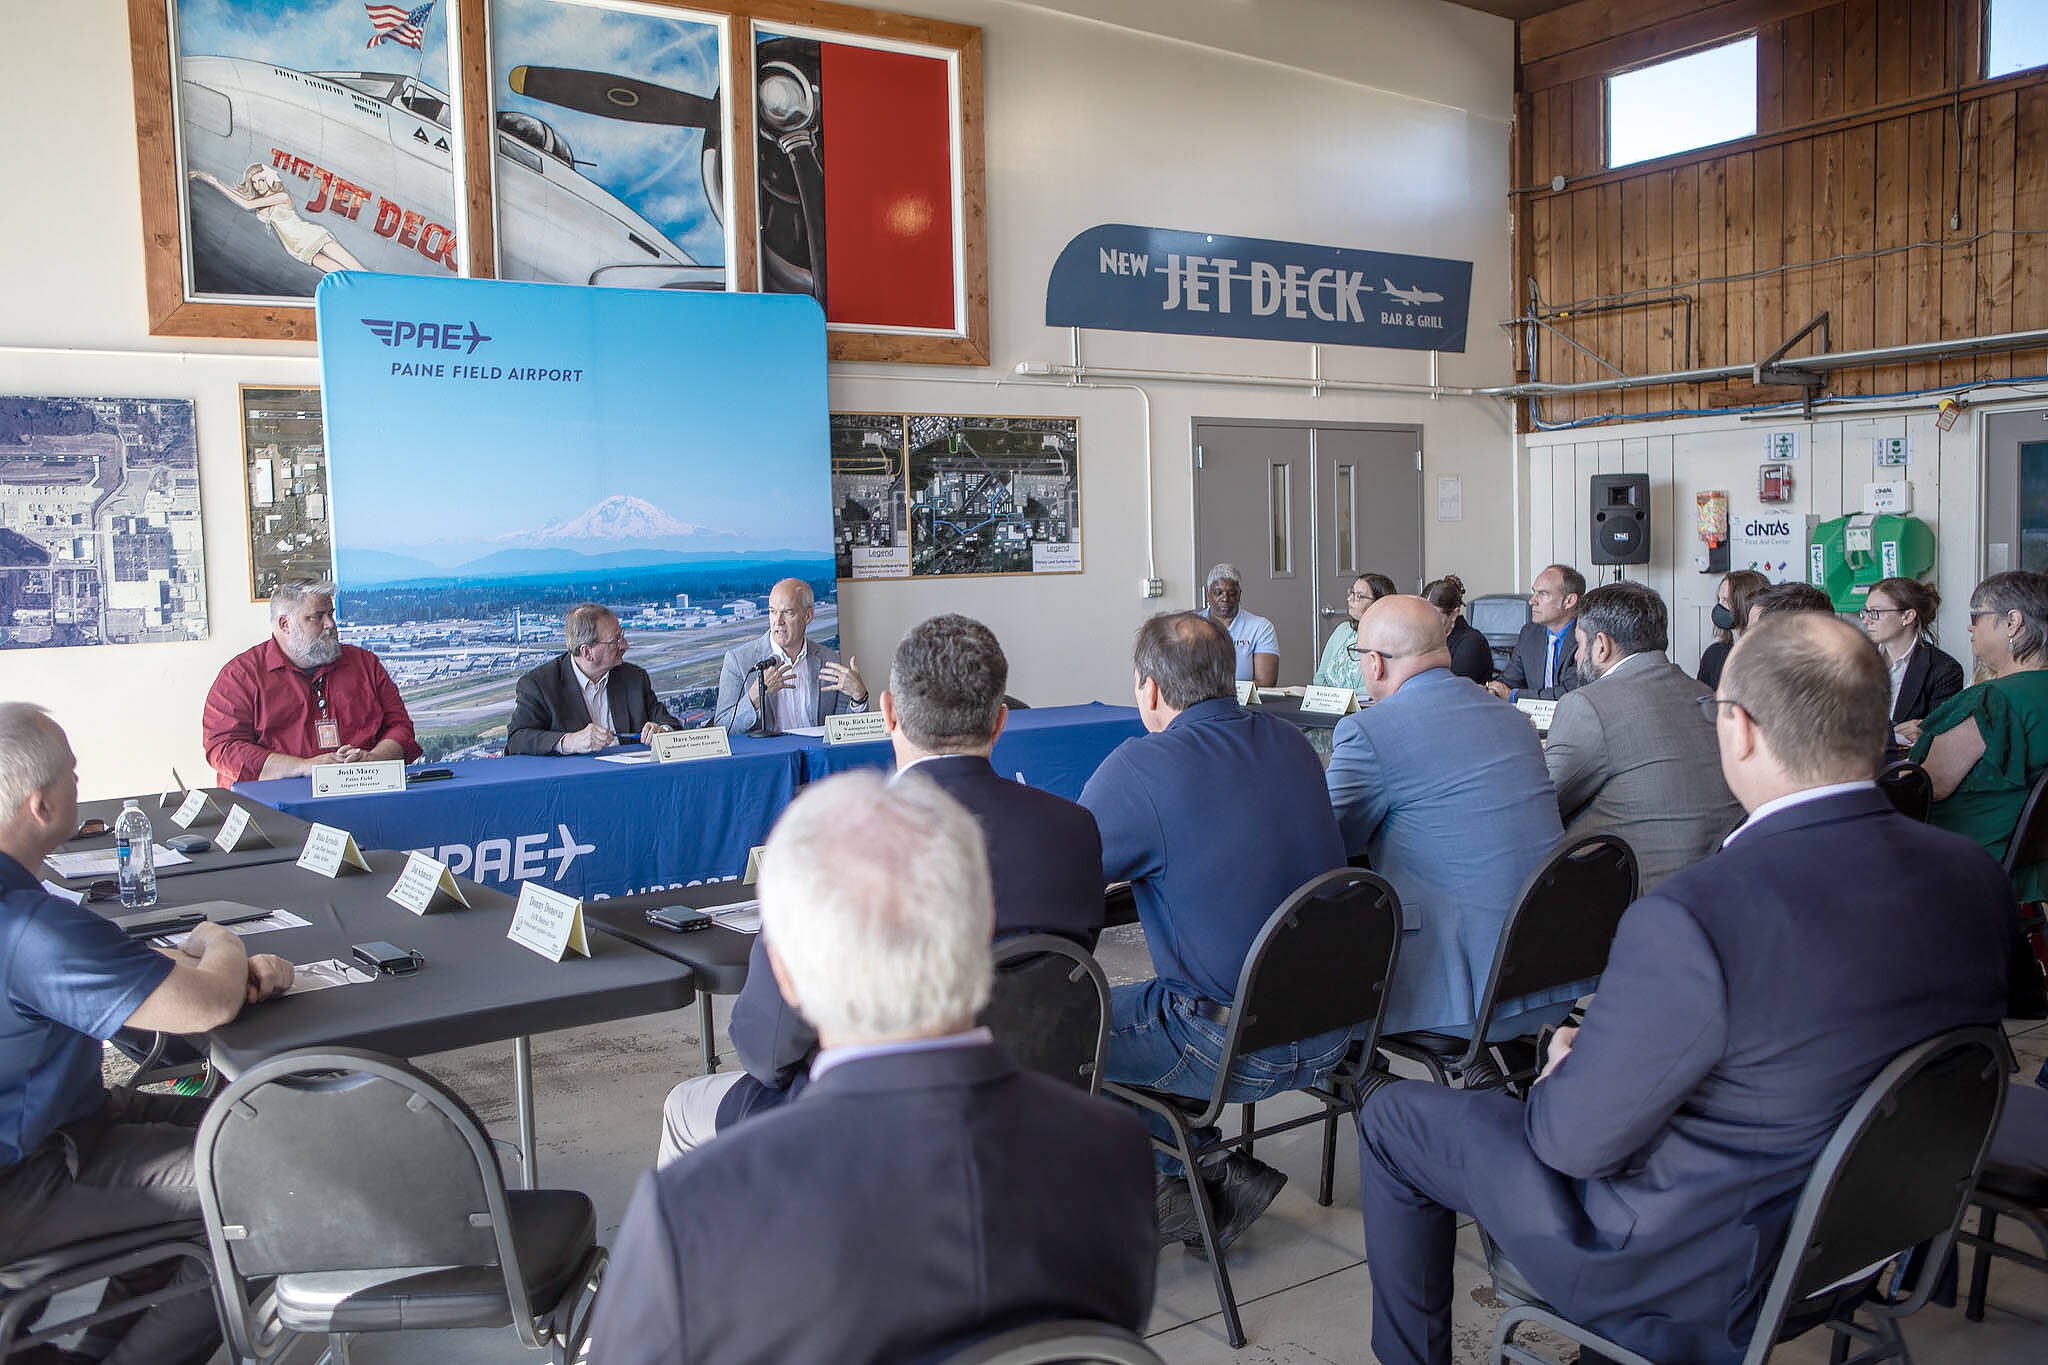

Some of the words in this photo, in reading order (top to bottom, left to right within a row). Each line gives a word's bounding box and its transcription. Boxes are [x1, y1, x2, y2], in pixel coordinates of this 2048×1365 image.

[272, 148, 314, 181] THE
[305, 165, 372, 221] JET
[1162, 253, 1238, 313] JET
[1251, 261, 1366, 323] DECK
[1381, 311, 1403, 325] BAR
[1405, 314, 1415, 327] &
[1417, 315, 1444, 329] GRILL
[394, 320, 464, 350] PAE
[391, 362, 445, 377] PAINE
[453, 365, 502, 380] FIELD
[508, 367, 583, 382] AIRPORT
[869, 548, 894, 558] Legend
[1047, 544, 1070, 553] Legend
[337, 768, 354, 776] Josh
[356, 768, 379, 776] Marcy
[439, 832, 549, 884] PAE
